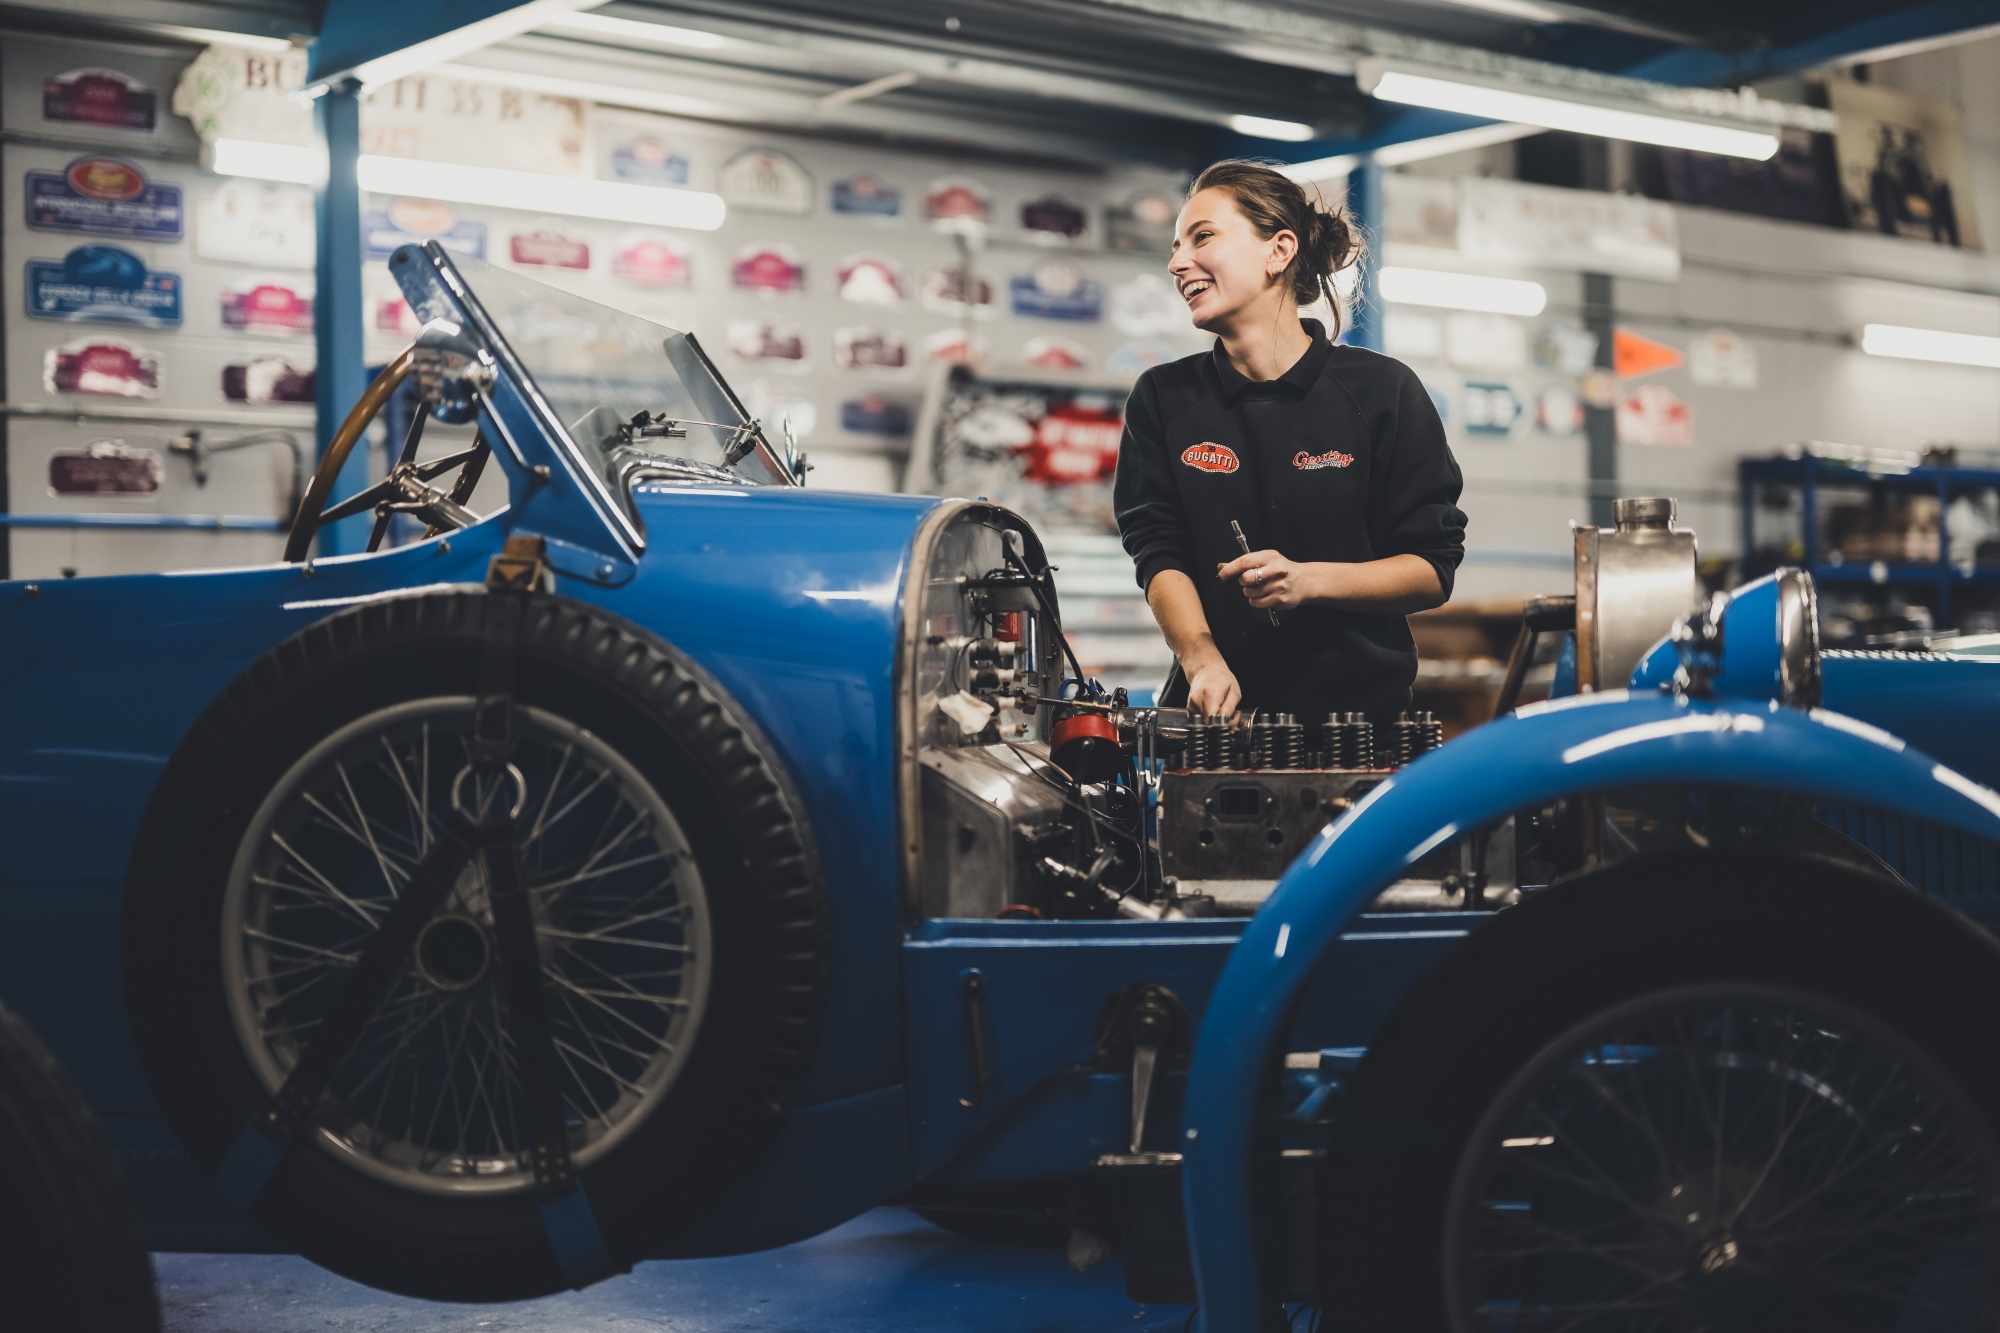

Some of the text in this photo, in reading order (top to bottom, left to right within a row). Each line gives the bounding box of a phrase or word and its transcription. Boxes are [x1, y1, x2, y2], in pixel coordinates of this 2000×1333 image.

[500, 87, 523, 119] B
[1187, 451, 1233, 469] BUGATTI
[1292, 449, 1355, 470] Gentry
